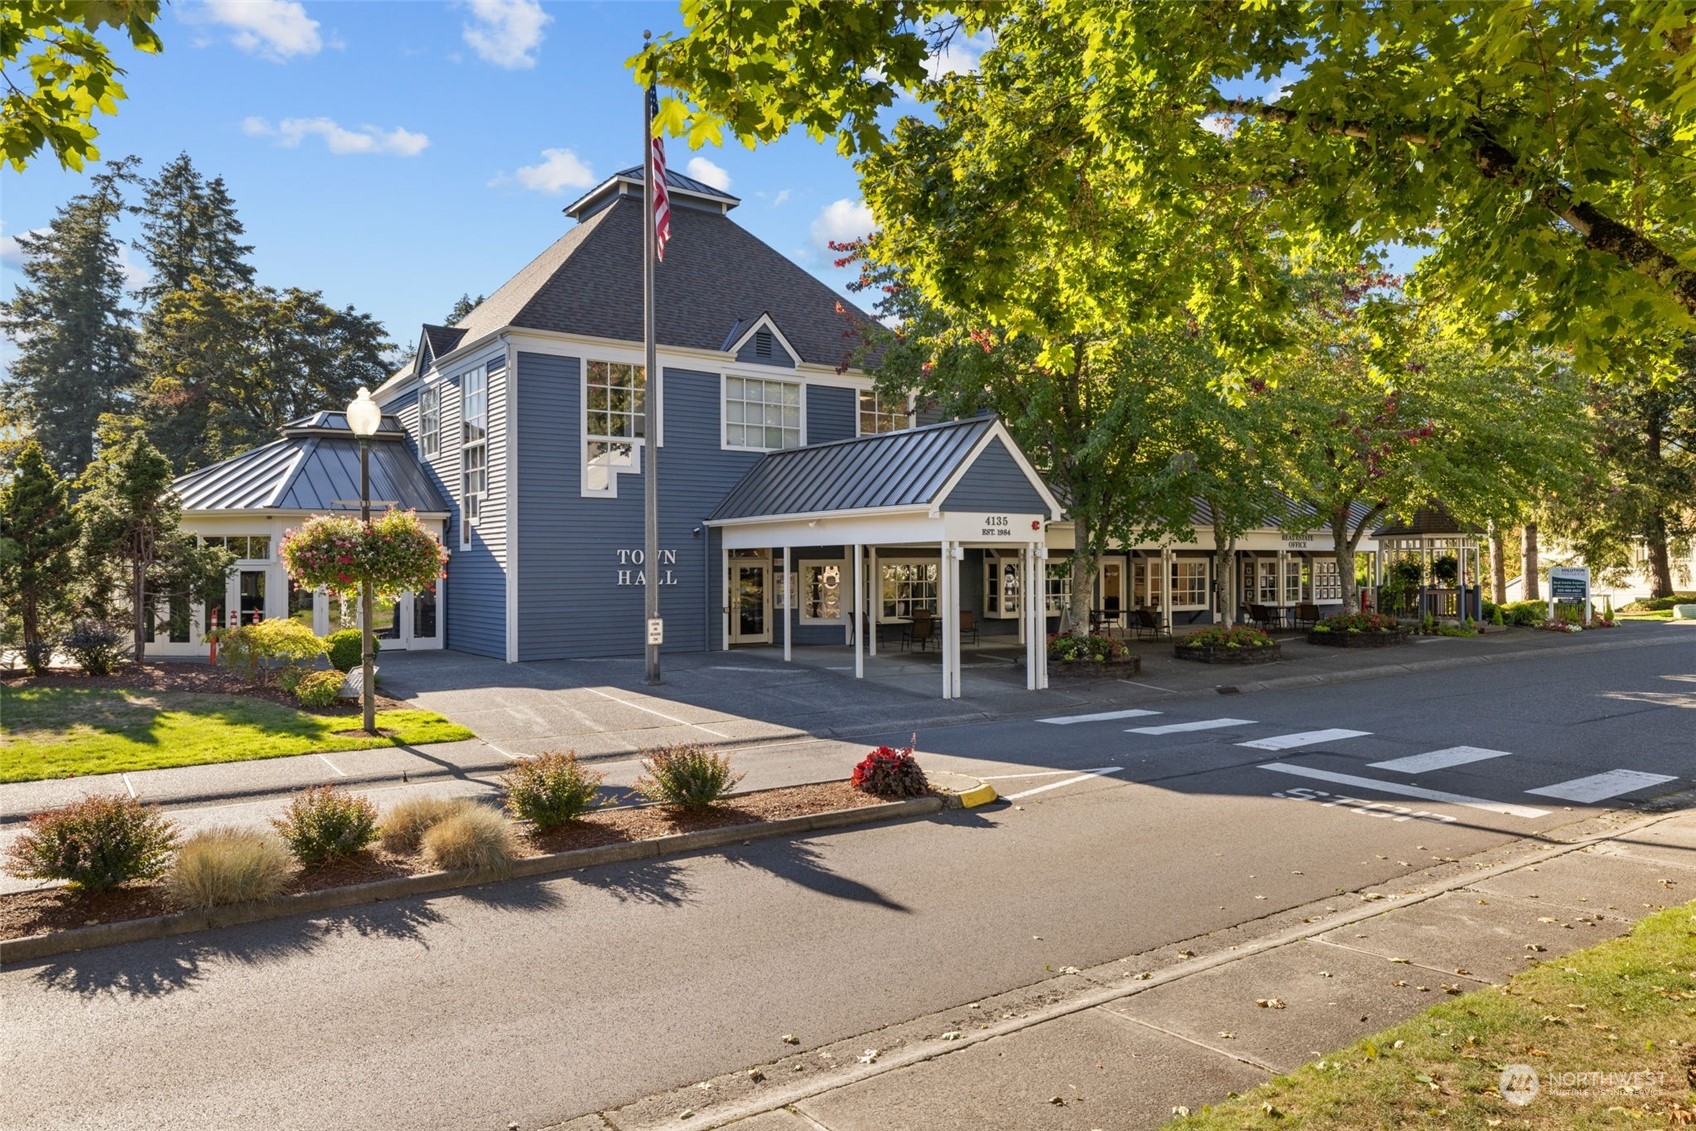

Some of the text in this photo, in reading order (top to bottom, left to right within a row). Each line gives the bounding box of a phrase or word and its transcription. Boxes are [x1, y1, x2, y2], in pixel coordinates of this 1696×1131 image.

[985, 516, 1008, 526] 4135
[617, 549, 677, 565] TON
[617, 570, 678, 585] HAL
[1272, 787, 1458, 822] STOP
